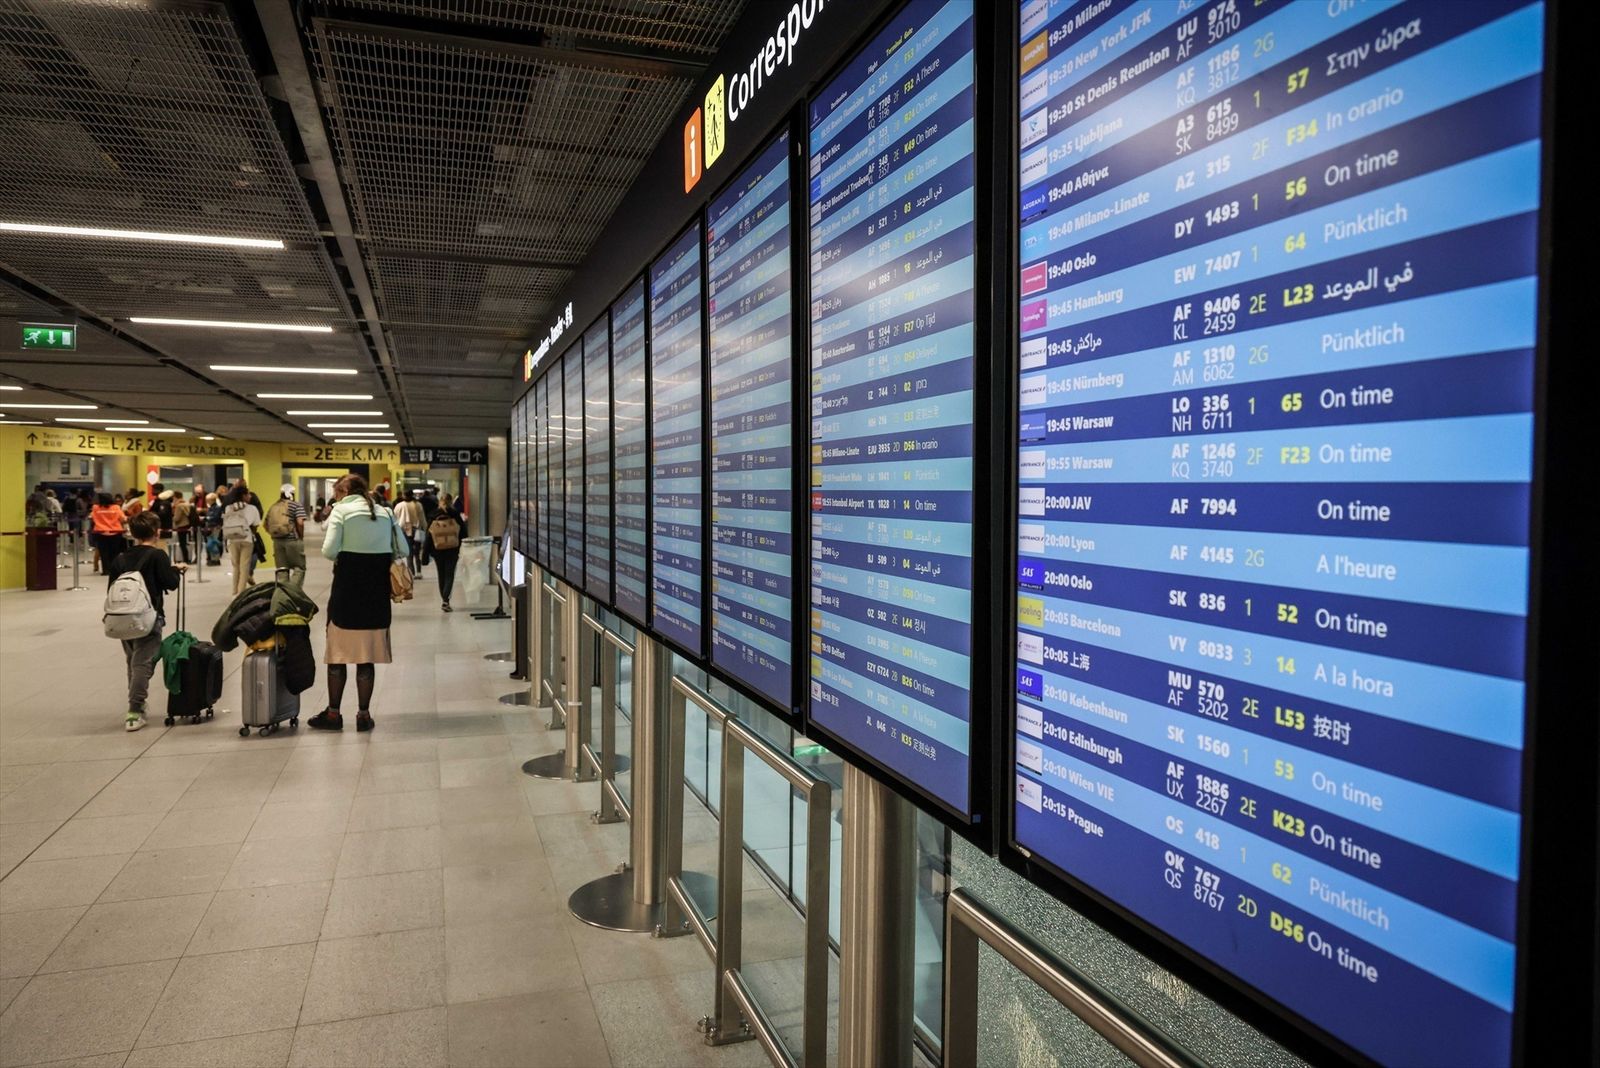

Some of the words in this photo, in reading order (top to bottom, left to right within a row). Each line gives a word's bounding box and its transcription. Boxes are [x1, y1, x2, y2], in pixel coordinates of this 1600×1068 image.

[1075, 0, 1112, 32] Milano
[1101, 25, 1127, 51] York
[1129, 8, 1151, 35] JFK
[1207, 10, 1241, 45] 5010
[728, 0, 831, 122] Correspo
[1048, 100, 1074, 125] 19:30
[1074, 91, 1086, 111] St
[1088, 75, 1118, 104] Denis
[1120, 45, 1171, 84] Reunion
[1177, 16, 1198, 40] UU
[1207, 0, 1236, 26] 974
[904, 78, 914, 94] F32
[1074, 115, 1124, 155] Ljubljana
[1207, 44, 1240, 75] 1186
[1048, 179, 1073, 204] 19:40
[1074, 165, 1110, 192] Αθήνα
[1206, 97, 1232, 124] 615
[1287, 66, 1310, 94] 57
[1326, 43, 1370, 76] Στην
[1375, 17, 1422, 53] ώρα
[1206, 111, 1239, 142] 8499
[916, 132, 925, 146] On
[925, 123, 938, 141] time
[1074, 190, 1151, 231] Milano-Linate
[1175, 170, 1196, 193] AZ
[1206, 153, 1232, 180] 315
[1286, 118, 1318, 147] F34
[1326, 111, 1343, 132] In
[1348, 87, 1404, 122] orario
[1048, 257, 1073, 281] 19:40
[1074, 251, 1097, 271] Oslo
[1174, 217, 1195, 240] DY
[1205, 200, 1240, 228] 1493
[1285, 176, 1307, 200] 56
[1324, 165, 1350, 187] On
[1355, 148, 1399, 176] time
[1074, 286, 1124, 312] Hamburg
[1174, 263, 1196, 285] EW
[1205, 250, 1241, 276] 7407
[1284, 232, 1307, 253] 64
[1324, 203, 1408, 243] Pünktlich
[1322, 266, 1378, 301] الموعد
[1384, 261, 1413, 293] في
[1203, 293, 1241, 318] 9406
[1283, 283, 1314, 307] L23
[1173, 302, 1192, 322] AF
[1203, 312, 1236, 337] 2459
[1047, 337, 1072, 357] 19:45
[1073, 371, 1124, 392] Nürnberg
[1203, 344, 1236, 364] 1310
[1322, 322, 1405, 354] Pünktlich
[1072, 415, 1114, 430] Warsaw
[1172, 396, 1190, 414] LO
[1202, 394, 1229, 413] 336
[1281, 392, 1302, 413] 65
[1320, 388, 1345, 409] On
[1351, 385, 1394, 406] time
[1202, 411, 1233, 430] 6711
[78, 434, 95, 449] 2E
[314, 448, 334, 461] 2E
[1071, 455, 1113, 470] Warsaw
[1202, 442, 1236, 460] 1246
[1280, 446, 1311, 465] F23
[1319, 444, 1344, 463] On
[1350, 443, 1392, 463] time
[915, 500, 924, 511] On
[924, 500, 937, 511] time
[1071, 496, 1092, 511] JAV
[1170, 498, 1189, 515] AF
[1201, 498, 1237, 516] 7994
[1317, 499, 1343, 520] On
[1348, 500, 1391, 522] time
[1071, 536, 1095, 552] Lyon
[1200, 546, 1234, 564] 4145
[1316, 554, 1329, 574] A
[1335, 554, 1397, 581] l'heure
[1021, 567, 1034, 578] SAS
[1071, 574, 1093, 591] Oslo
[1169, 589, 1187, 608] SK
[1199, 592, 1226, 612] 836
[1277, 603, 1299, 624] 52
[1315, 608, 1341, 630] On
[1346, 613, 1388, 638] time
[1070, 613, 1121, 637] Barcelona
[1168, 634, 1188, 653] VY
[1199, 639, 1233, 662] 8033
[1277, 656, 1296, 674] 14
[1314, 663, 1327, 683] A
[1332, 665, 1347, 687] la
[1352, 669, 1394, 697] hora
[913, 680, 922, 692] On
[923, 683, 935, 697] time
[1043, 646, 1069, 664] 20:05
[1070, 651, 1091, 672] 上海
[1168, 670, 1192, 690] MU
[1198, 679, 1224, 701] 570
[1275, 706, 1305, 731] L53
[1312, 714, 1352, 746] 按时
[1198, 697, 1229, 721] 5202
[1069, 690, 1128, 724] København
[1167, 725, 1185, 744] SK
[1197, 734, 1231, 758] 1560
[1274, 759, 1295, 781] 53
[1312, 771, 1337, 795] On
[1342, 782, 1383, 811] time
[1043, 721, 1067, 741] 20:10
[1069, 729, 1123, 765] Edinburgh
[1167, 760, 1184, 780] AF
[1196, 774, 1229, 800] 1886
[1272, 809, 1306, 838] K23
[1310, 824, 1335, 851] On
[1340, 836, 1382, 870] time
[1195, 791, 1228, 817] 2267
[1068, 770, 1094, 793] Wien
[1097, 787, 1115, 802] VIE
[1166, 815, 1184, 835] OS
[1195, 828, 1220, 850] 418
[1271, 862, 1292, 885] 62
[1309, 876, 1390, 931] Pünktlich
[1042, 795, 1067, 818] 20:15
[1068, 808, 1104, 838] Prague
[1164, 850, 1185, 873] OK
[1194, 866, 1221, 891] 767
[1237, 894, 1258, 918] 2D
[1269, 911, 1305, 943] D56
[1307, 931, 1332, 960] On
[1336, 947, 1379, 983] time
[1194, 884, 1225, 911] 8767
